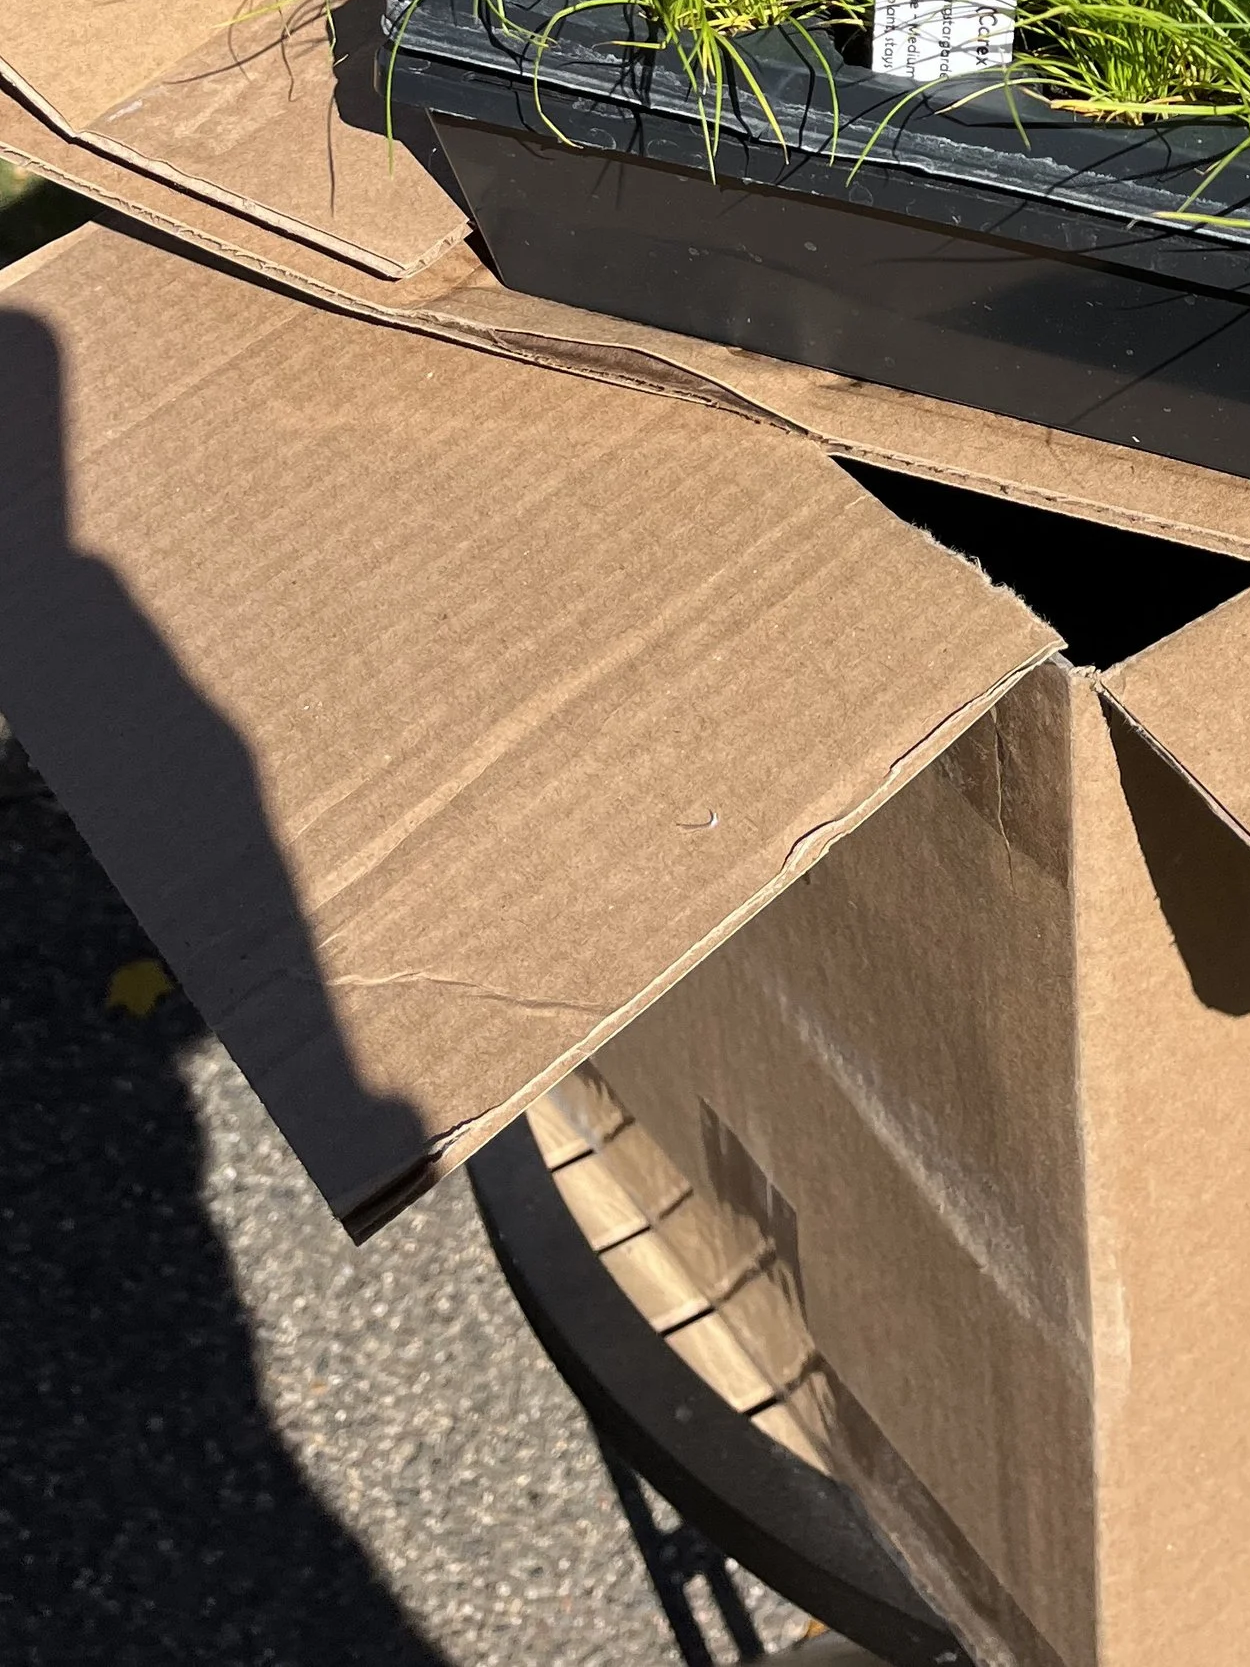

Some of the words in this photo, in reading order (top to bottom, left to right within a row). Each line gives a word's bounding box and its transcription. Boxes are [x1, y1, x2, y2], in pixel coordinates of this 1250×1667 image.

[882, 37, 898, 68] stays
[906, 23, 920, 79] Medium
[976, 7, 998, 66] (Carex
